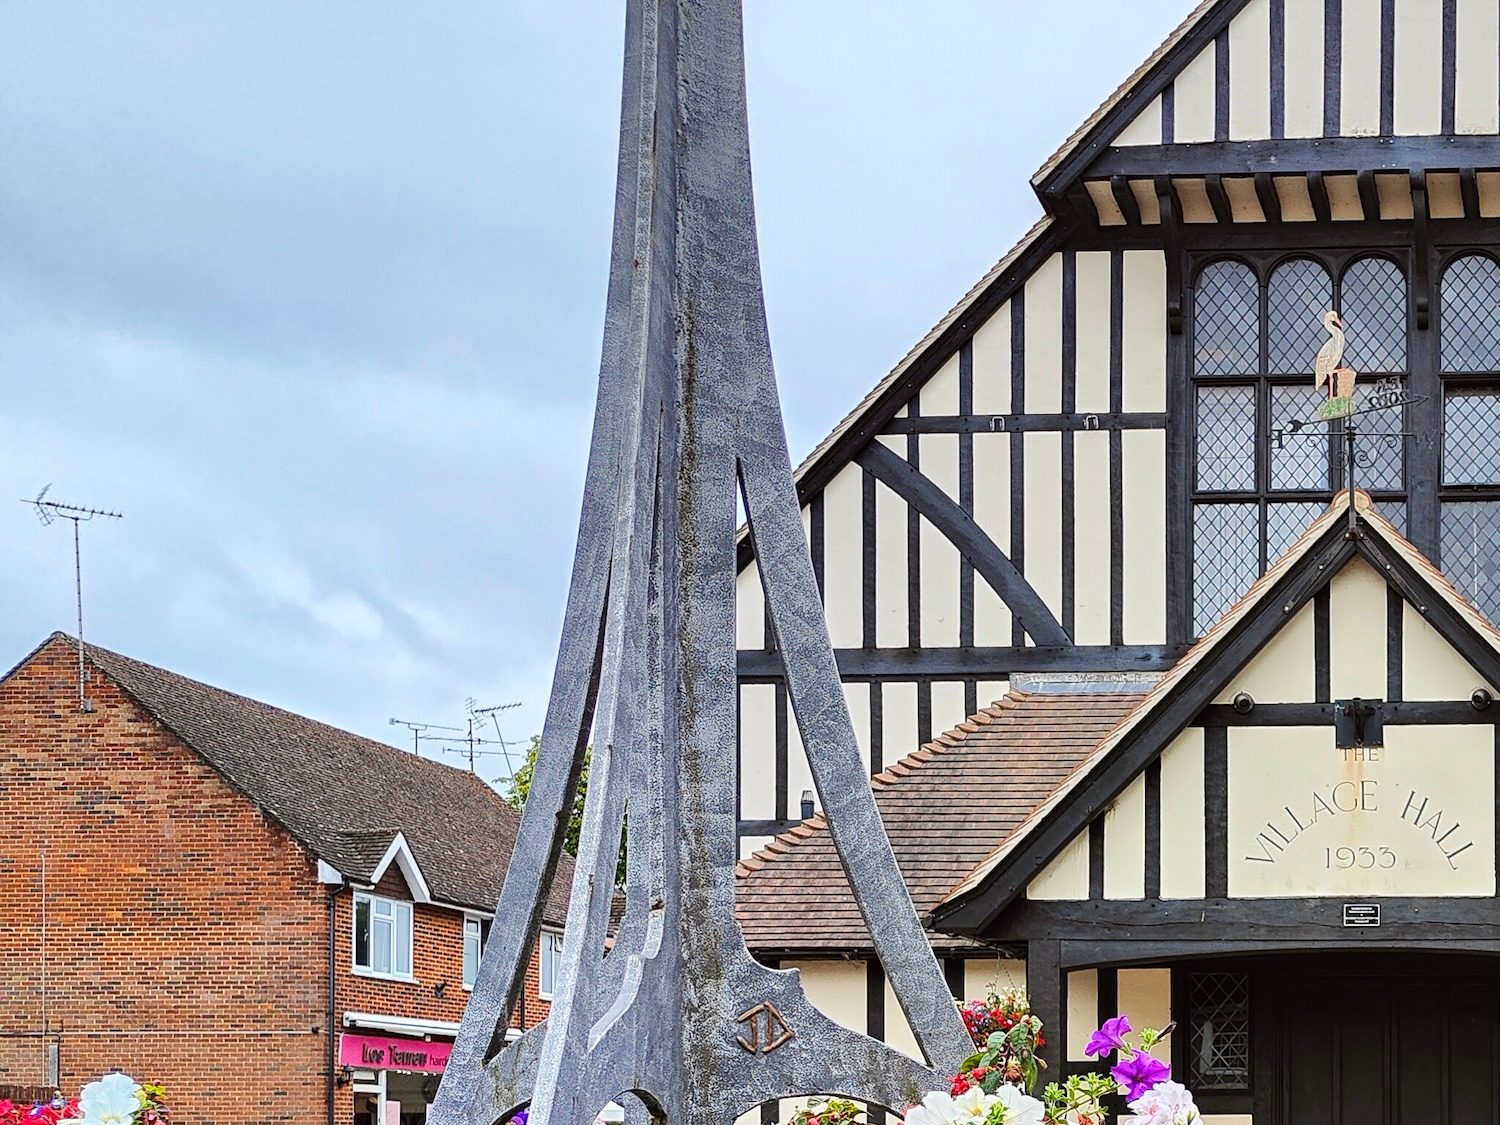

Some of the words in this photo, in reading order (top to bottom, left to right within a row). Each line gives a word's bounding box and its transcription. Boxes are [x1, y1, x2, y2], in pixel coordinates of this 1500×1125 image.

[1340, 748, 1380, 761] THE
[1244, 780, 1378, 864] VILLAGE
[1400, 790, 1474, 870] HALL
[1325, 847, 1397, 869] 1933
